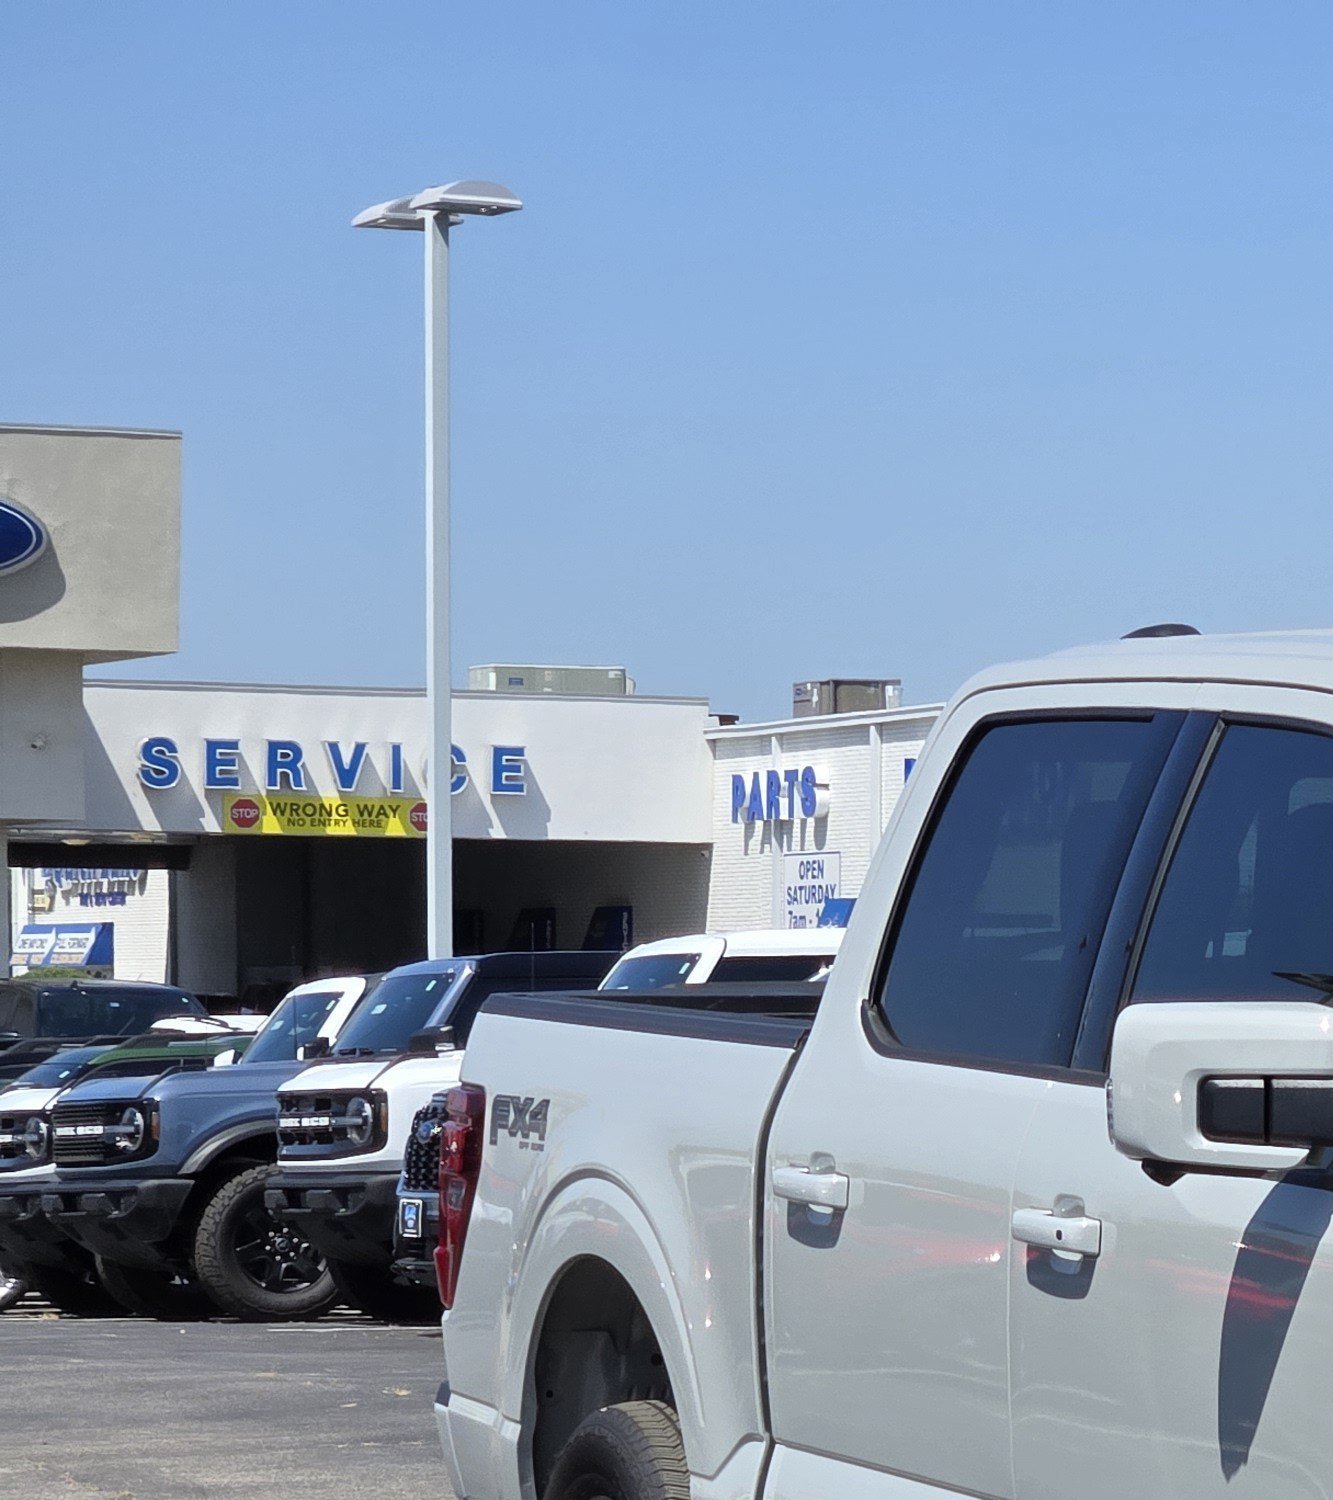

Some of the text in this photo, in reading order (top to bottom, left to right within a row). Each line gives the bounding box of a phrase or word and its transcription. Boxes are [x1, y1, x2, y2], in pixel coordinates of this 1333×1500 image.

[731, 766, 817, 824] PARTS
[231, 808, 259, 819] STOP
[269, 801, 401, 819] WRONG WAY
[410, 811, 428, 822] STO
[287, 818, 383, 828] NO ENTRY HERE
[799, 859, 824, 880] OPEN
[786, 883, 837, 905] SATURDAY
[489, 1094, 550, 1146] FX4
